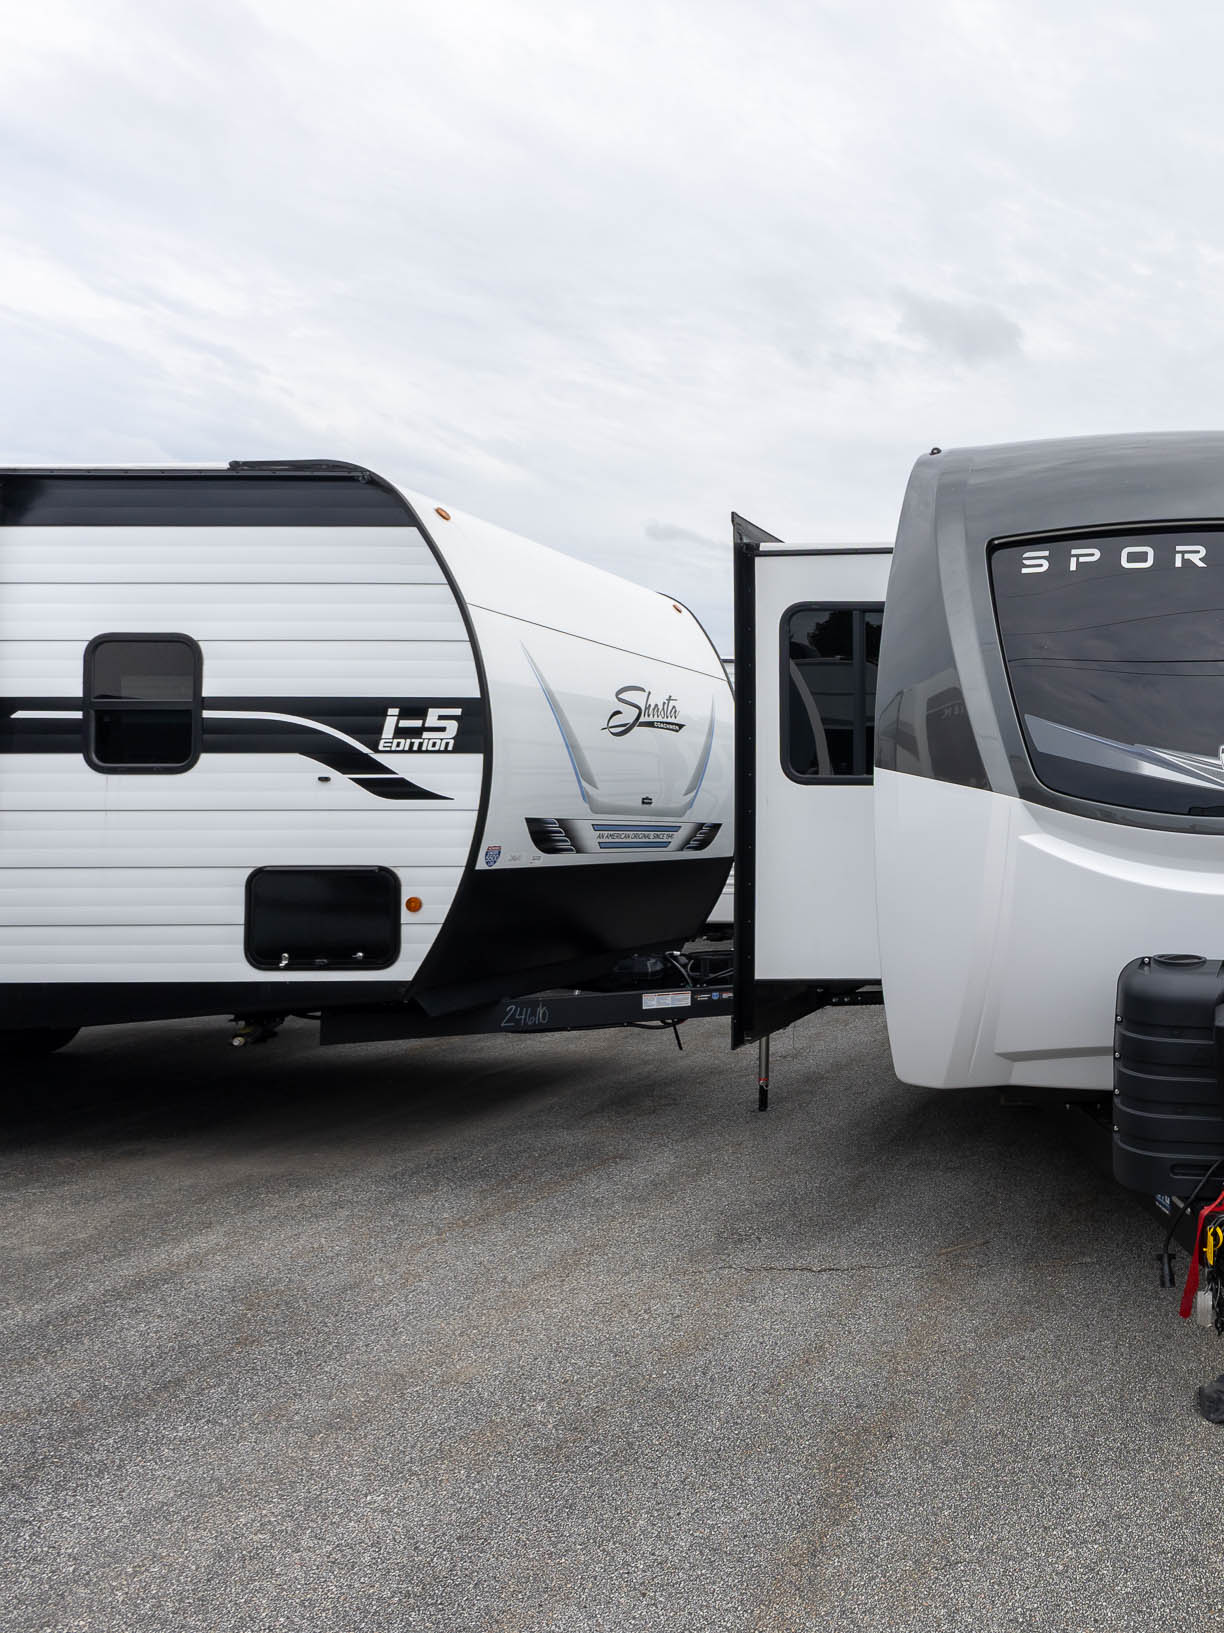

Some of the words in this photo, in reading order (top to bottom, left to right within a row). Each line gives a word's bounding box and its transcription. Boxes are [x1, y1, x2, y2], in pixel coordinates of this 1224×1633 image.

[606, 685, 680, 737] Shasta
[378, 738, 455, 751] EDITION
[596, 832, 605, 840] AN
[605, 832, 631, 840] AMERICAN
[631, 832, 652, 840] ORIGINAL
